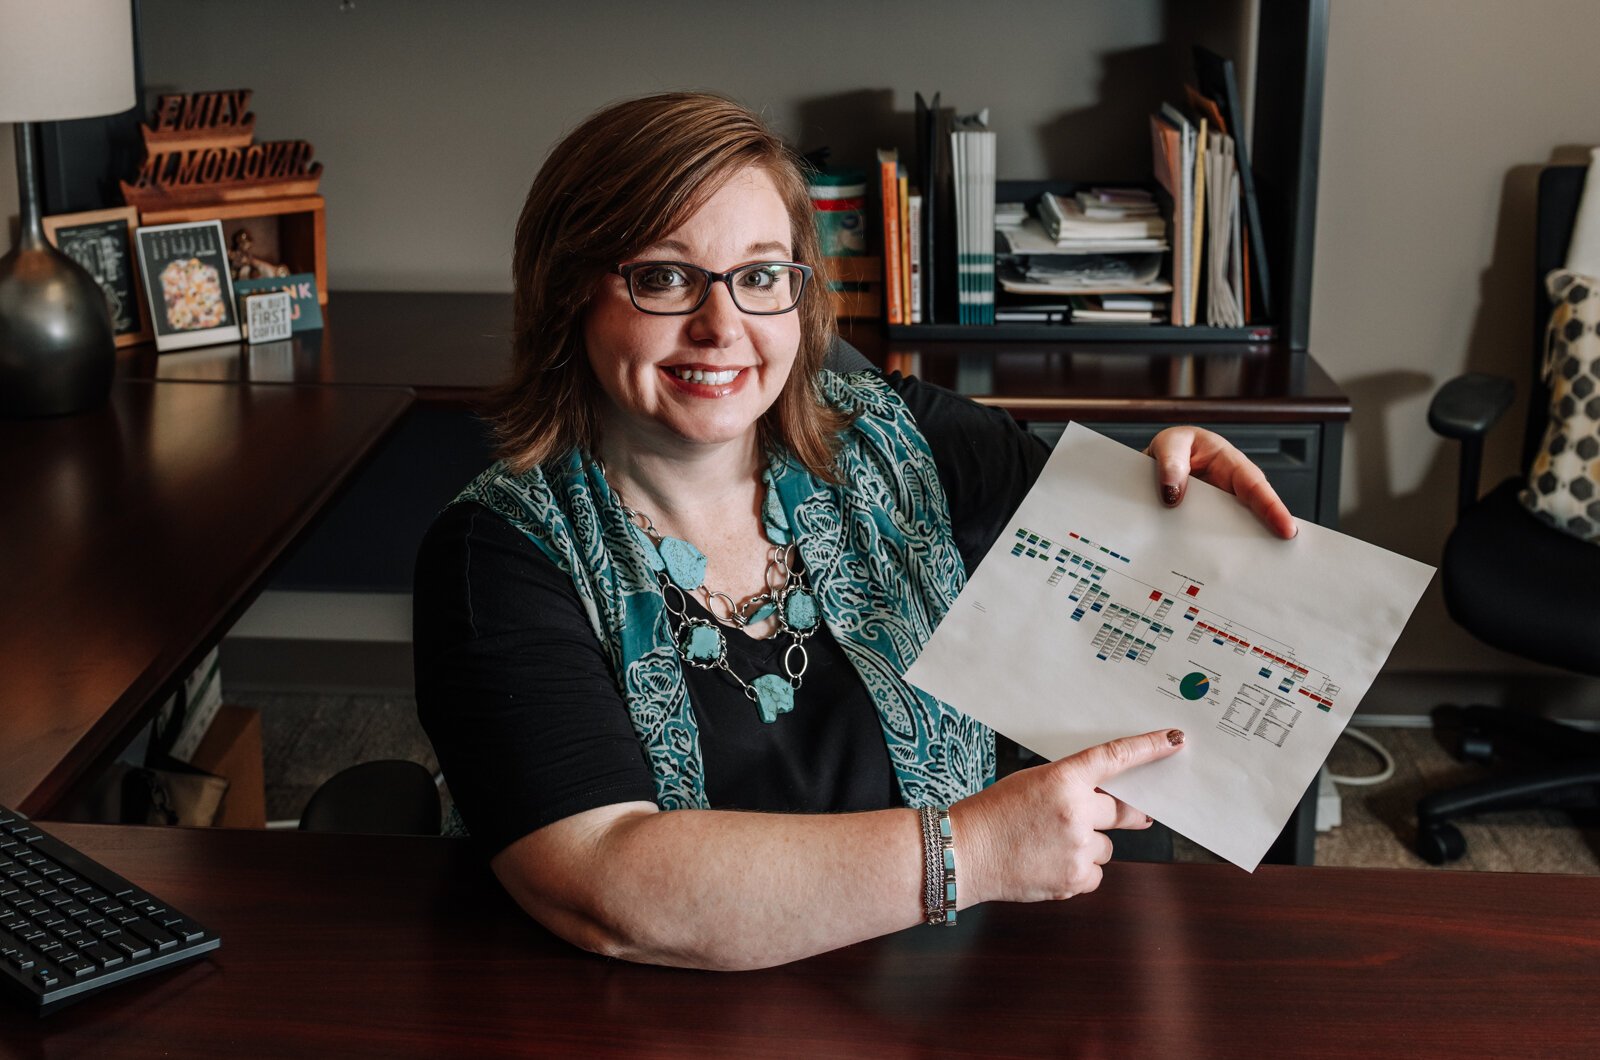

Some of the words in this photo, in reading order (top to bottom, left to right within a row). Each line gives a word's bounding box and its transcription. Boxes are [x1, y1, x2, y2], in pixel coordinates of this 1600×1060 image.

[155, 89, 253, 131] EMILY
[133, 140, 314, 188] ALMODOVAR
[268, 297, 285, 309] BUT
[252, 308, 286, 325] FIRST
[253, 324, 287, 339] COFFEE
